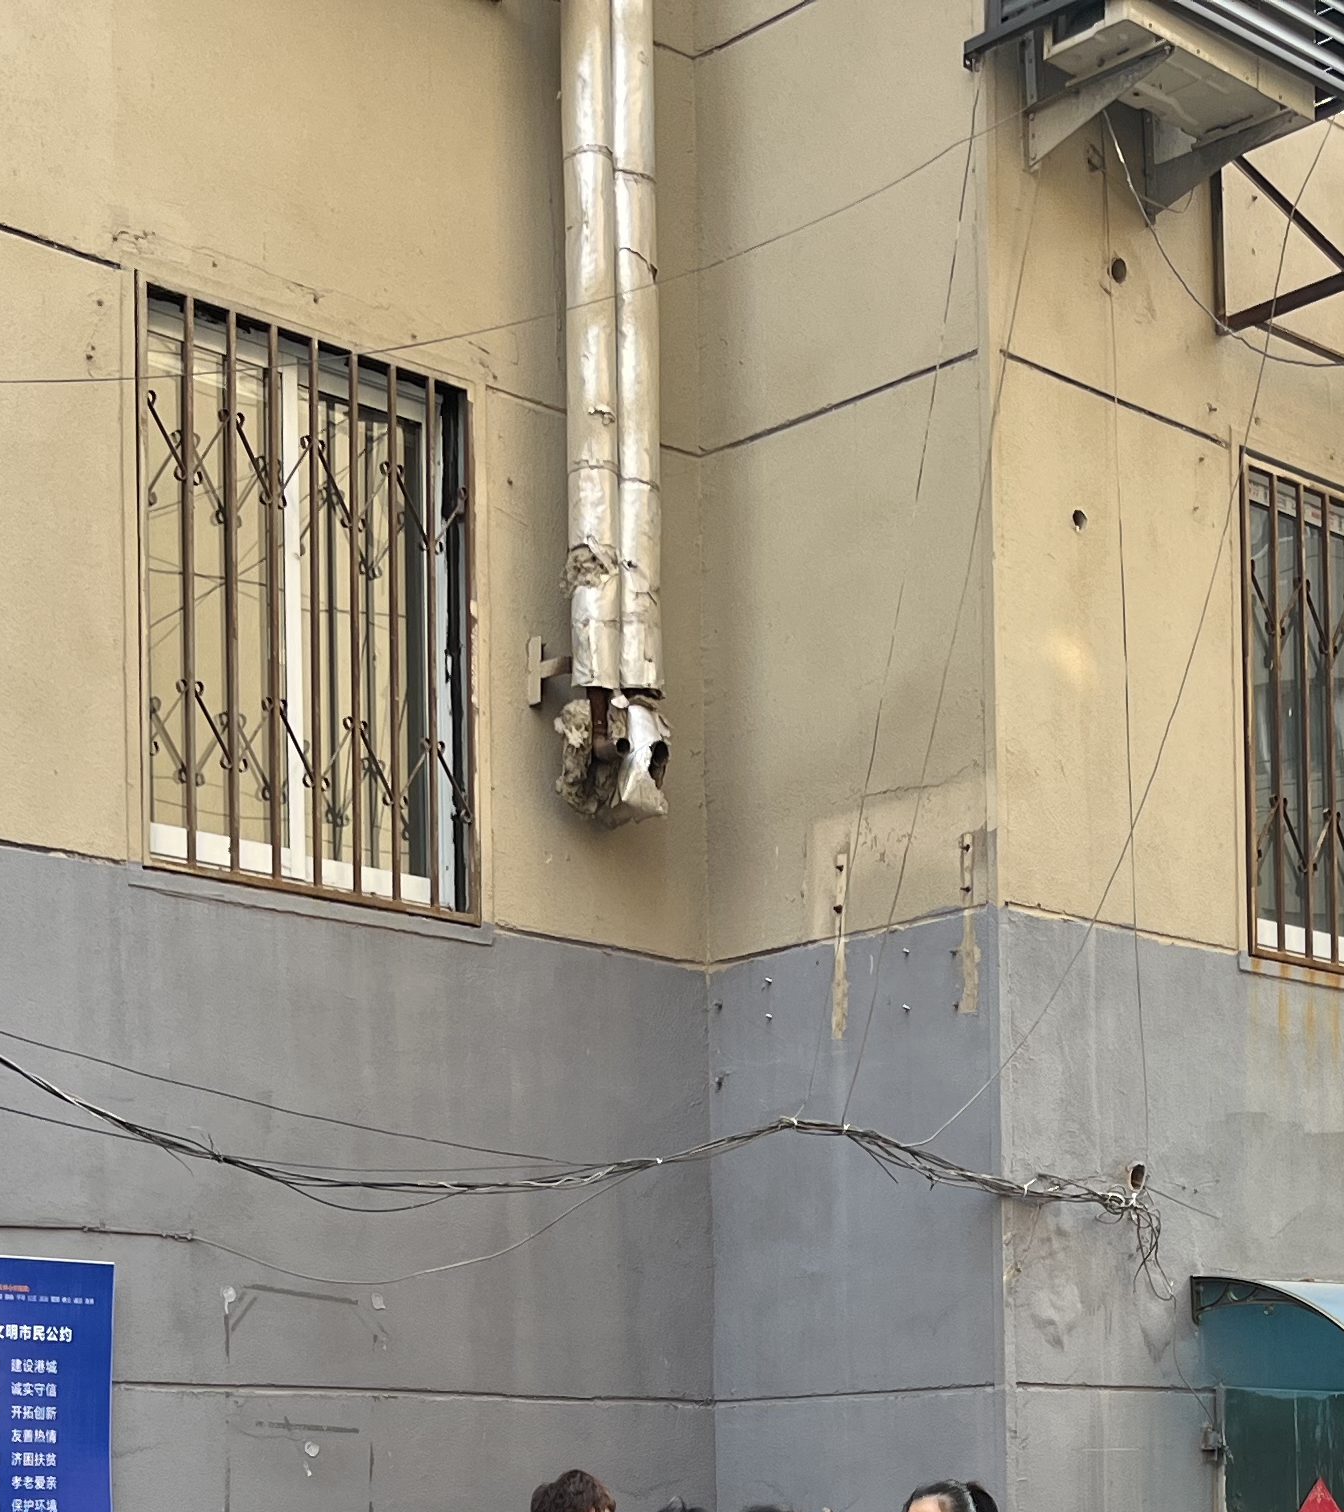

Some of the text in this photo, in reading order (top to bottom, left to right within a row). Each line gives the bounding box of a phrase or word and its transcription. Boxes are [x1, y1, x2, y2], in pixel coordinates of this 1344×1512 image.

[10, 1358, 58, 1374] 建设港城
[10, 1382, 58, 1397] 诚实守信
[10, 1406, 58, 1420] 开拓创新
[10, 1429, 58, 1444] 友善热情
[10, 1452, 58, 1467] 济困扶贫
[10, 1476, 58, 1490] 孝老爱亲
[10, 1499, 58, 1512] 保护环境
